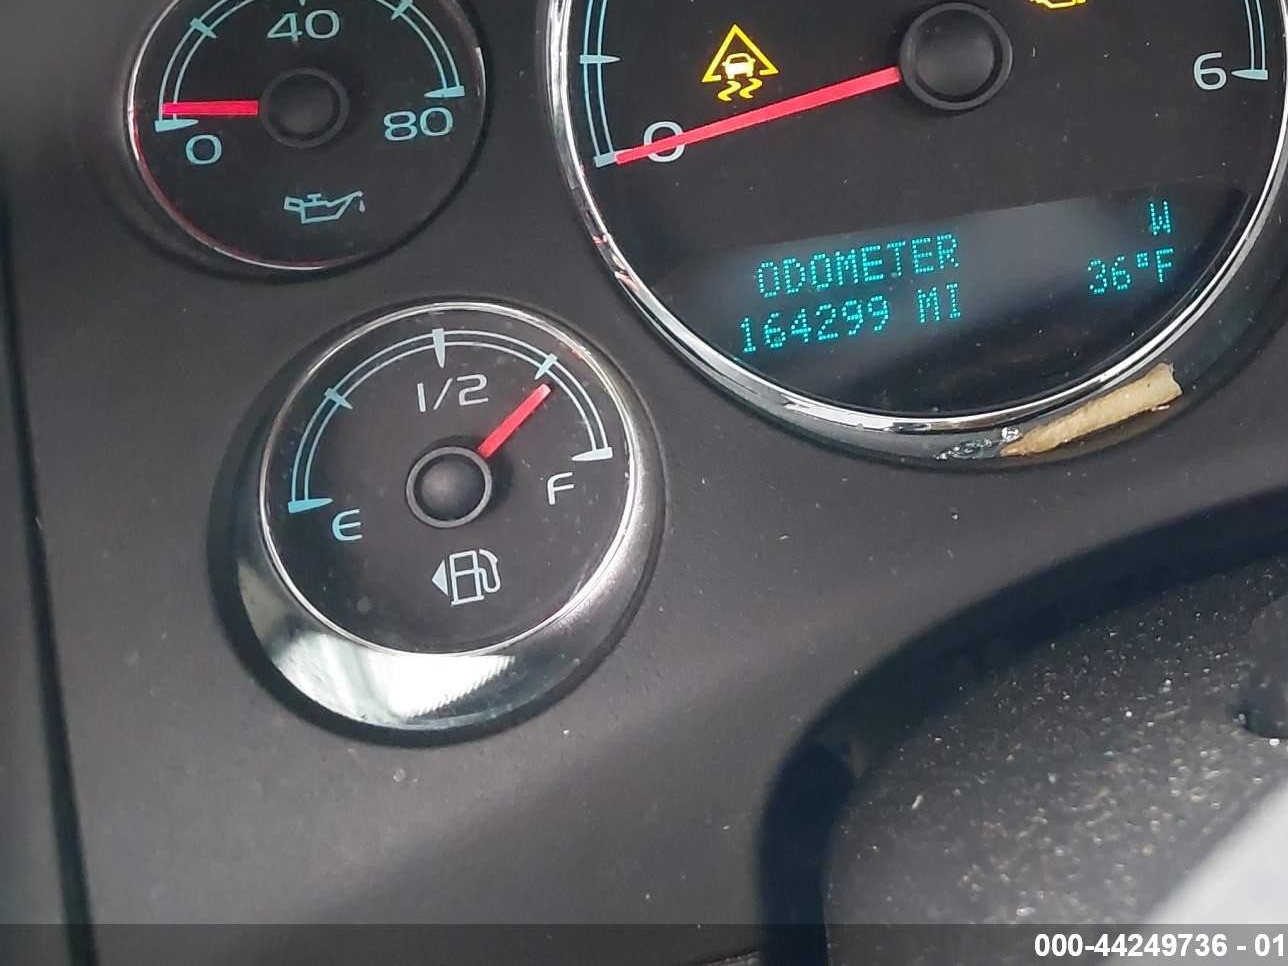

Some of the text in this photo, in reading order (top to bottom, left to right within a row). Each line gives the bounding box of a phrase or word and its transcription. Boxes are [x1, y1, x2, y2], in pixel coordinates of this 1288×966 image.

[267, 10, 341, 44] 40
[1192, 52, 1226, 90] 6
[384, 107, 454, 141] 80
[643, 121, 686, 162] 0
[185, 134, 222, 165] 0
[1149, 200, 1173, 236] W
[756, 233, 959, 298] ODOMETER
[1087, 247, 1175, 295] 36°F
[740, 282, 961, 353] 164299 MI
[416, 373, 489, 413] 1/2
[546, 471, 575, 505] F
[331, 508, 363, 542] E
